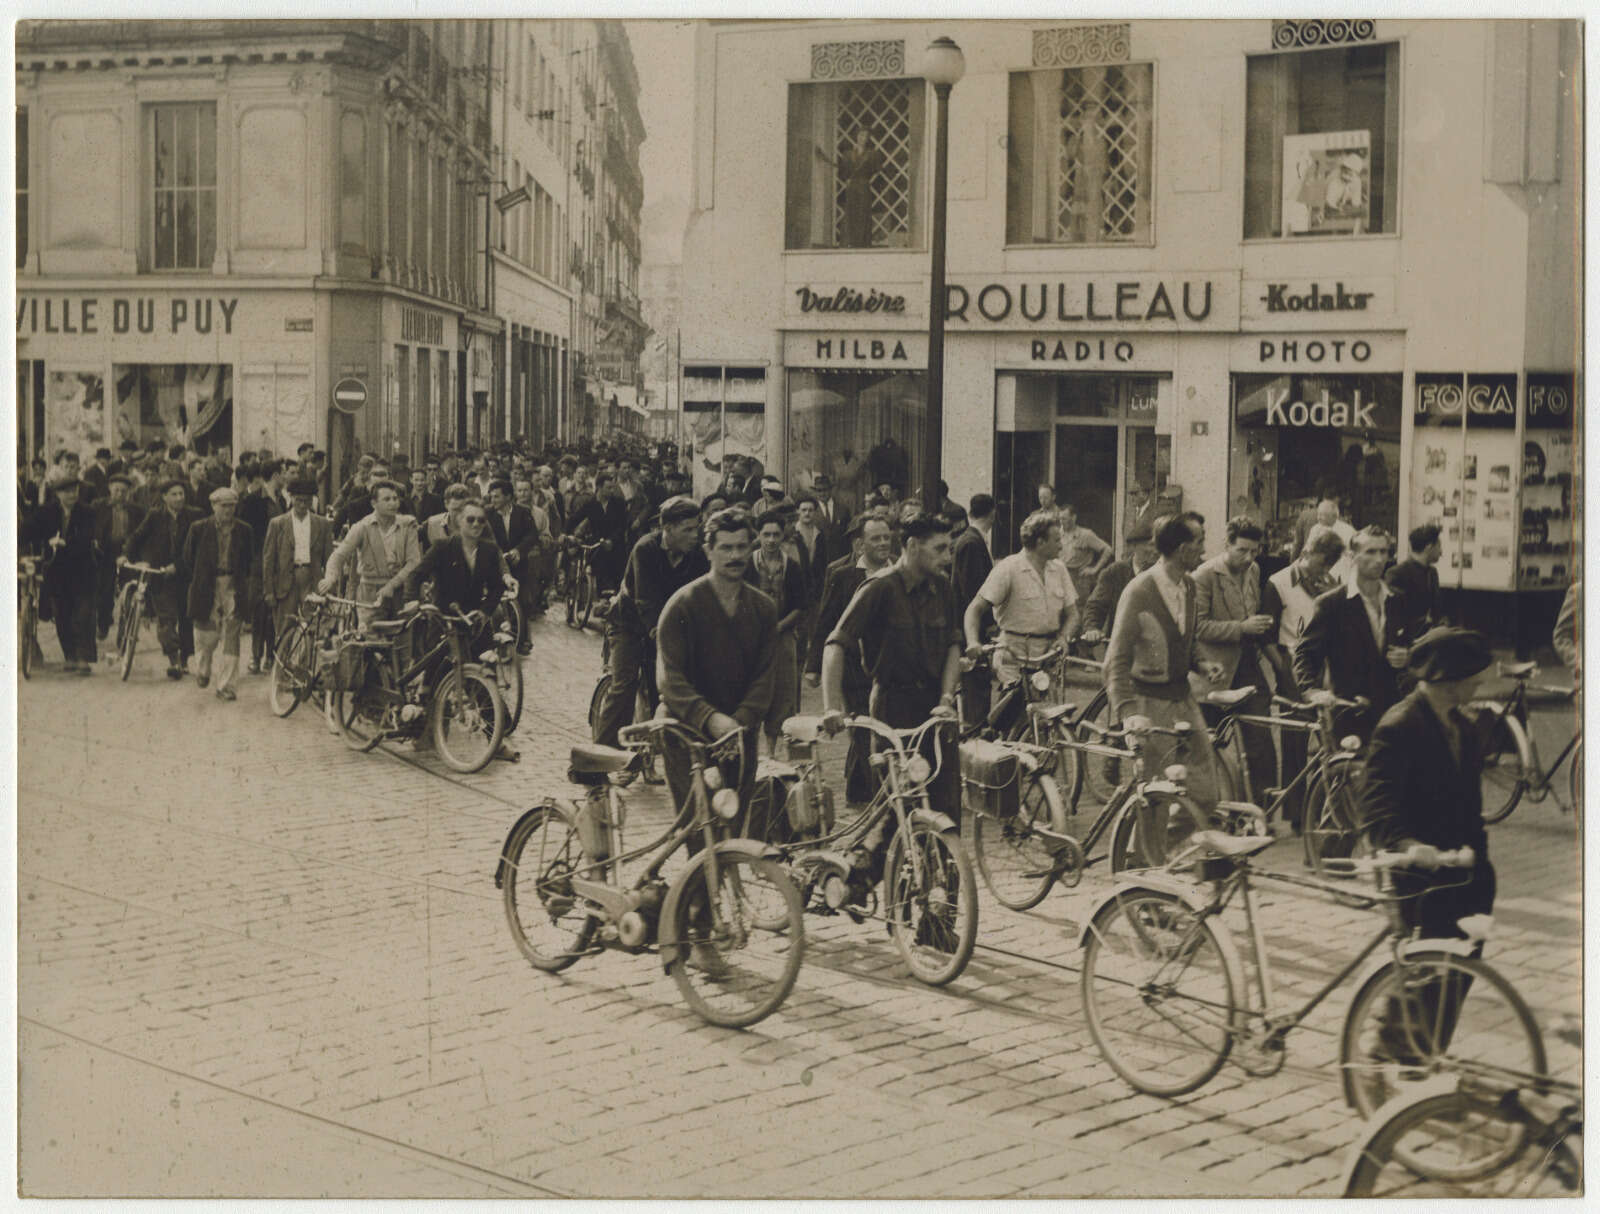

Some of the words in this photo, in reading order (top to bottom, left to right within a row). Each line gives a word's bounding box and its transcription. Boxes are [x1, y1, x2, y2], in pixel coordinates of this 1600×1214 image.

[796, 286, 905, 313] Valisère
[944, 281, 1212, 322] ROULLEAU
[16, 298, 98, 333] VILLE
[113, 298, 154, 334] DU
[171, 298, 238, 334] PUY
[816, 339, 907, 360] MILBA
[1031, 340, 1133, 362] RADIO
[1260, 340, 1371, 362] PHOTO
[1266, 389, 1376, 428] Kodak
[1418, 385, 1514, 413] FOCA
